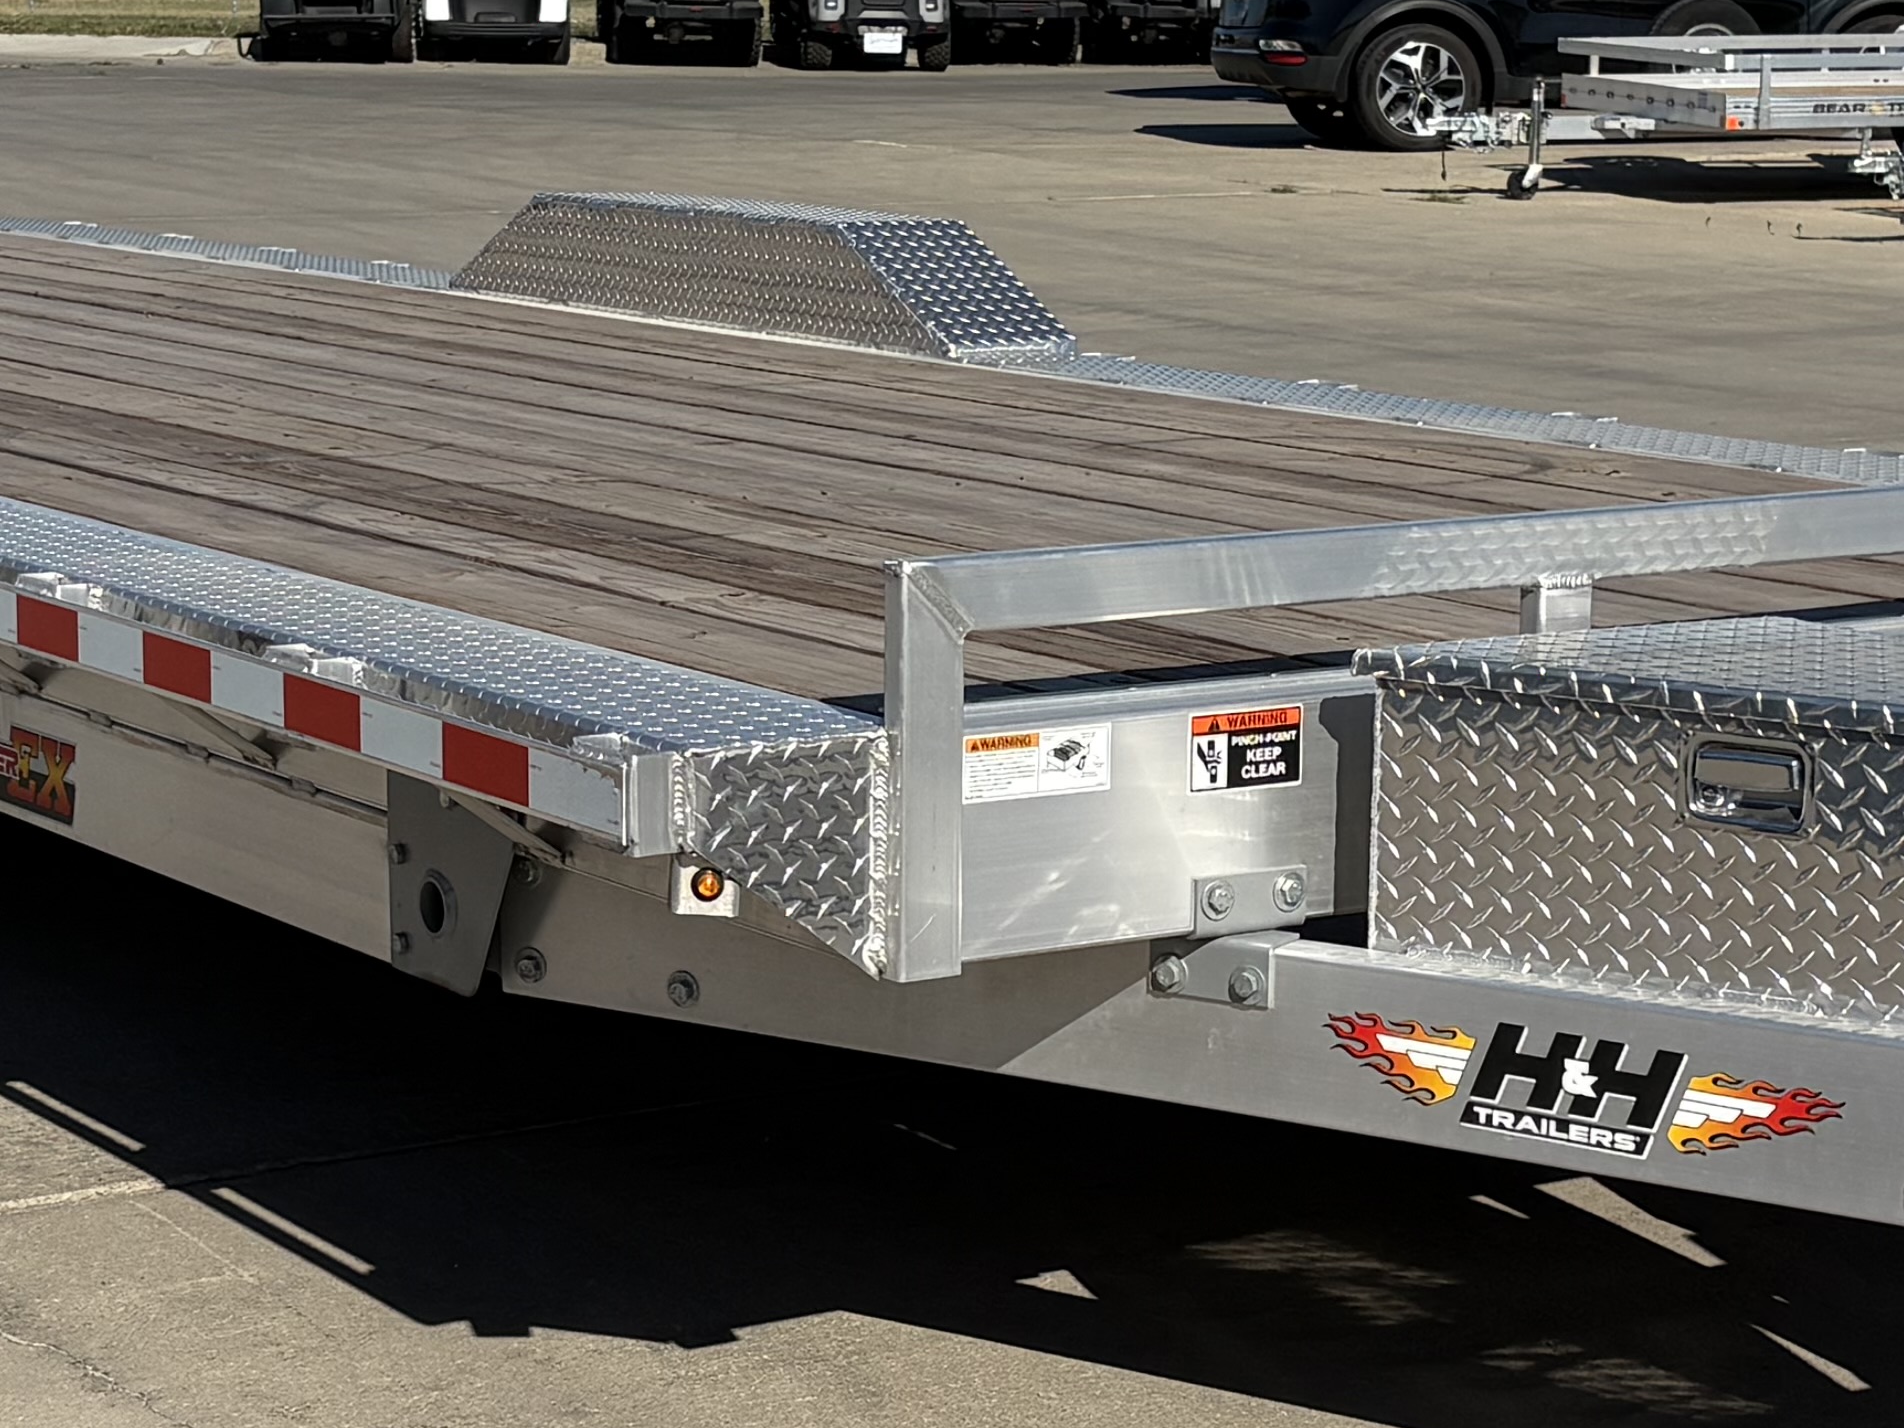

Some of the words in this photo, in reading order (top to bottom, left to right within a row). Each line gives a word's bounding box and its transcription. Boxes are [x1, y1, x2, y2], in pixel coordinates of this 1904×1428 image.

[1812, 103, 1866, 114] BEAR
[1227, 711, 1288, 729] WARNING
[980, 734, 1032, 751] WARNING
[1246, 746, 1282, 763] KEEP
[1241, 762, 1286, 780] CLEAR
[1470, 1022, 1688, 1134] H&H
[1472, 1105, 1637, 1152] TRAILERS
